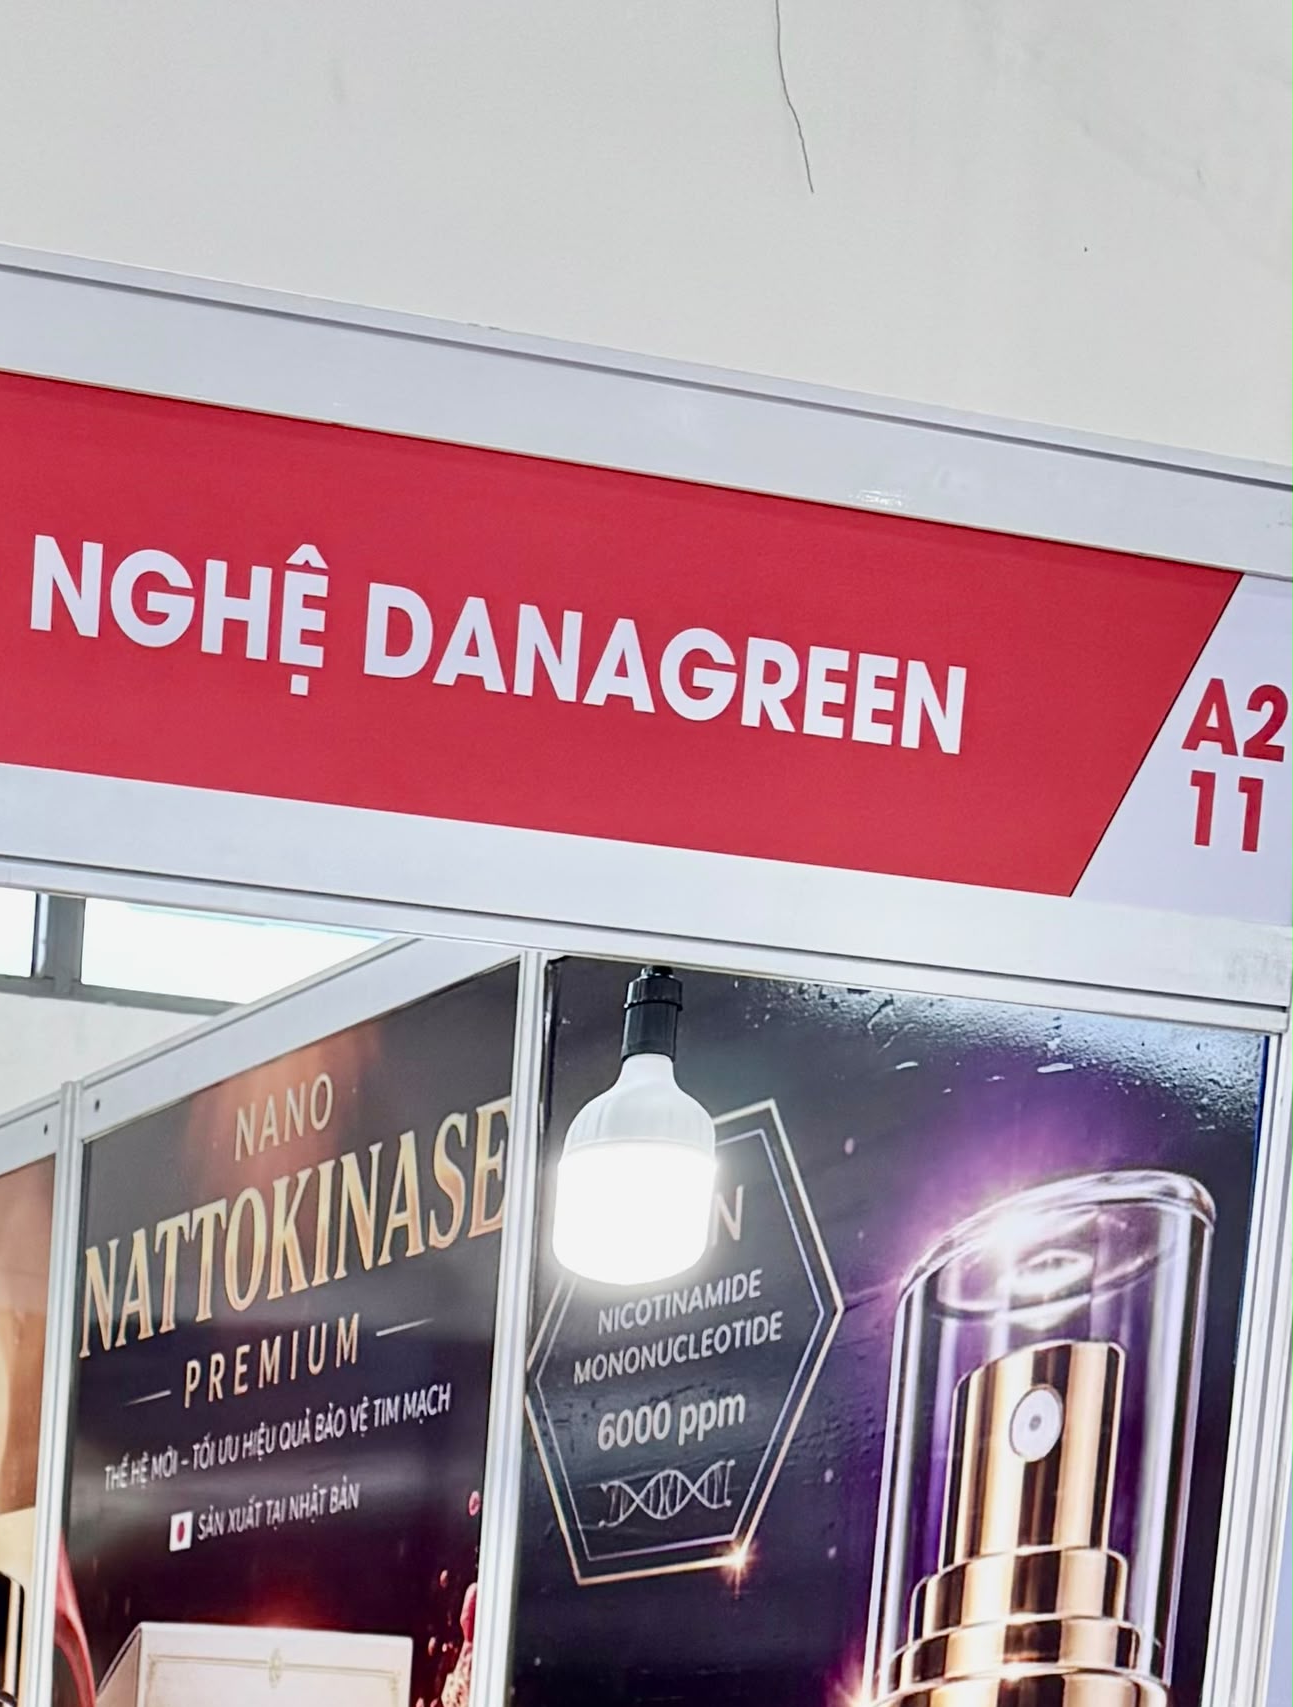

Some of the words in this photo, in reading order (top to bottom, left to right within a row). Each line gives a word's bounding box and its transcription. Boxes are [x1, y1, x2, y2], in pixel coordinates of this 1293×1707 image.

[30, 534, 329, 696] NGHỆ
[363, 582, 967, 755] DANAGREEN
[1182, 677, 1288, 762] A2
[1190, 769, 1263, 852] 11
[234, 1073, 334, 1162] NANO
[79, 1095, 511, 1359] NATTOKINASE
[597, 1269, 763, 1335] NICOTINAMIDE
[184, 1313, 360, 1408] PREMIUM
[573, 1311, 784, 1385] MONONUCLEOTIDE
[105, 1453, 130, 1491] THẾ
[131, 1451, 149, 1489] HỆ
[193, 1432, 215, 1471] TỐI
[242, 1421, 276, 1462] HIỆU
[279, 1407, 311, 1450] QUẢ
[315, 1402, 347, 1442] BẢO
[349, 1396, 369, 1438] VỆ
[373, 1394, 401, 1428] TIM
[403, 1382, 451, 1425] MẠCH
[597, 1401, 671, 1452] 6000
[678, 1392, 746, 1446] ppm
[197, 1505, 225, 1541] SẢN
[227, 1494, 263, 1534] XUẤT
[265, 1497, 286, 1531] TẠI
[288, 1483, 328, 1524] NHẬT
[329, 1474, 360, 1515] BẢN
